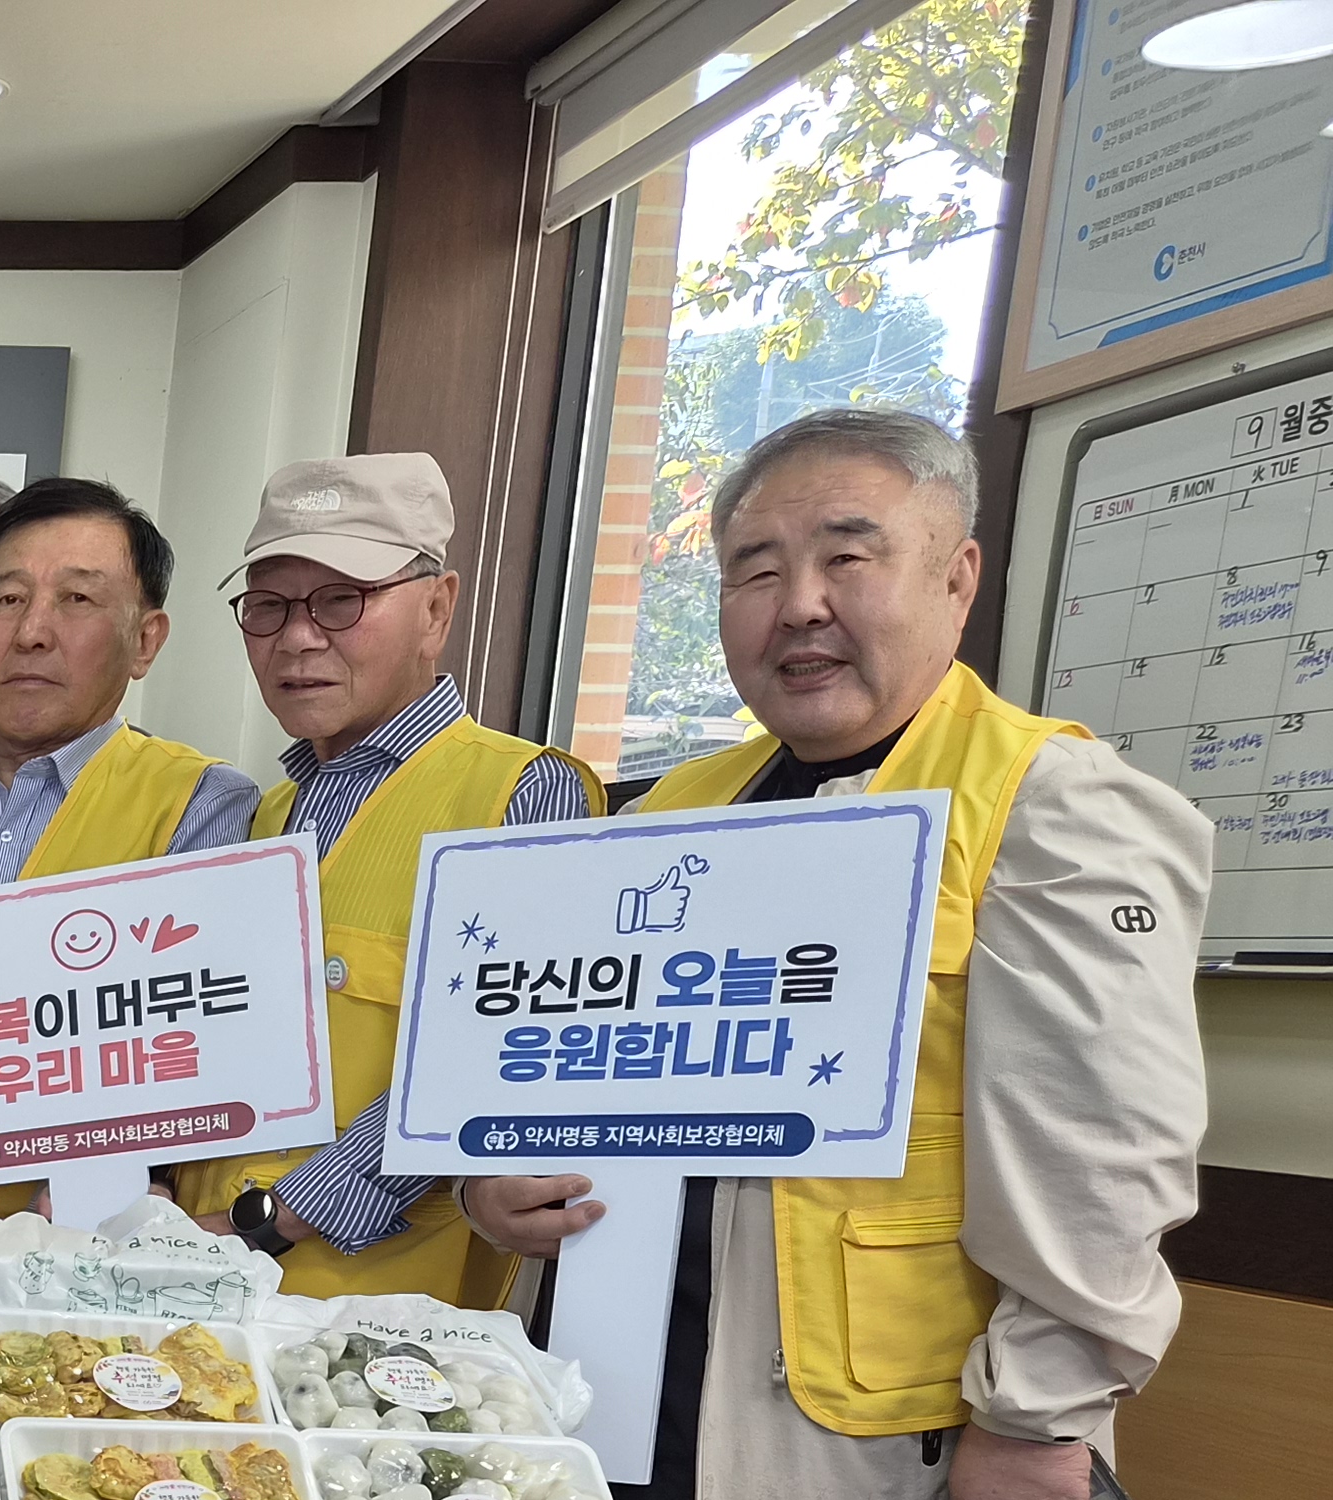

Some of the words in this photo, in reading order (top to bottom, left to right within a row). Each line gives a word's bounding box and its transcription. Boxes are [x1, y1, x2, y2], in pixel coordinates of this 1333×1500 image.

[1177, 242, 1206, 266] 춘천시
[1246, 415, 1264, 449] 9
[1093, 504, 1104, 521] 日
[1107, 498, 1134, 518] SUN
[1168, 485, 1180, 504] 月
[1183, 477, 1216, 499] MON
[1251, 465, 1266, 484] 火
[1270, 456, 1301, 480] TUE
[1069, 595, 1080, 615] 6
[1144, 584, 1156, 605] 7
[1227, 566, 1239, 585] 8
[1315, 549, 1329, 577] 9
[1057, 669, 1073, 688] 13
[1130, 656, 1149, 678] 14
[1209, 644, 1233, 666] 15
[1297, 632, 1317, 652] 16
[1117, 732, 1133, 752] 21
[1194, 724, 1219, 741] 22
[1280, 713, 1305, 733] 23
[1266, 792, 1289, 811] 30
[96, 967, 250, 1030] 머무는
[473, 952, 643, 1018] 당신의
[654, 942, 840, 1008] 오늘을
[99, 1030, 201, 1089] 마을
[497, 1017, 795, 1083] 응원합니다
[3, 1135, 70, 1159] 약사명동
[73, 1111, 230, 1150] 지역사회보장협의체
[523, 1124, 601, 1148] 약사명동
[604, 1122, 786, 1148] 지역사회보장협의체
[150, 1235, 199, 1250] nice
[356, 1319, 410, 1338] Have
[420, 1328, 433, 1342] a
[443, 1327, 493, 1343] nice
